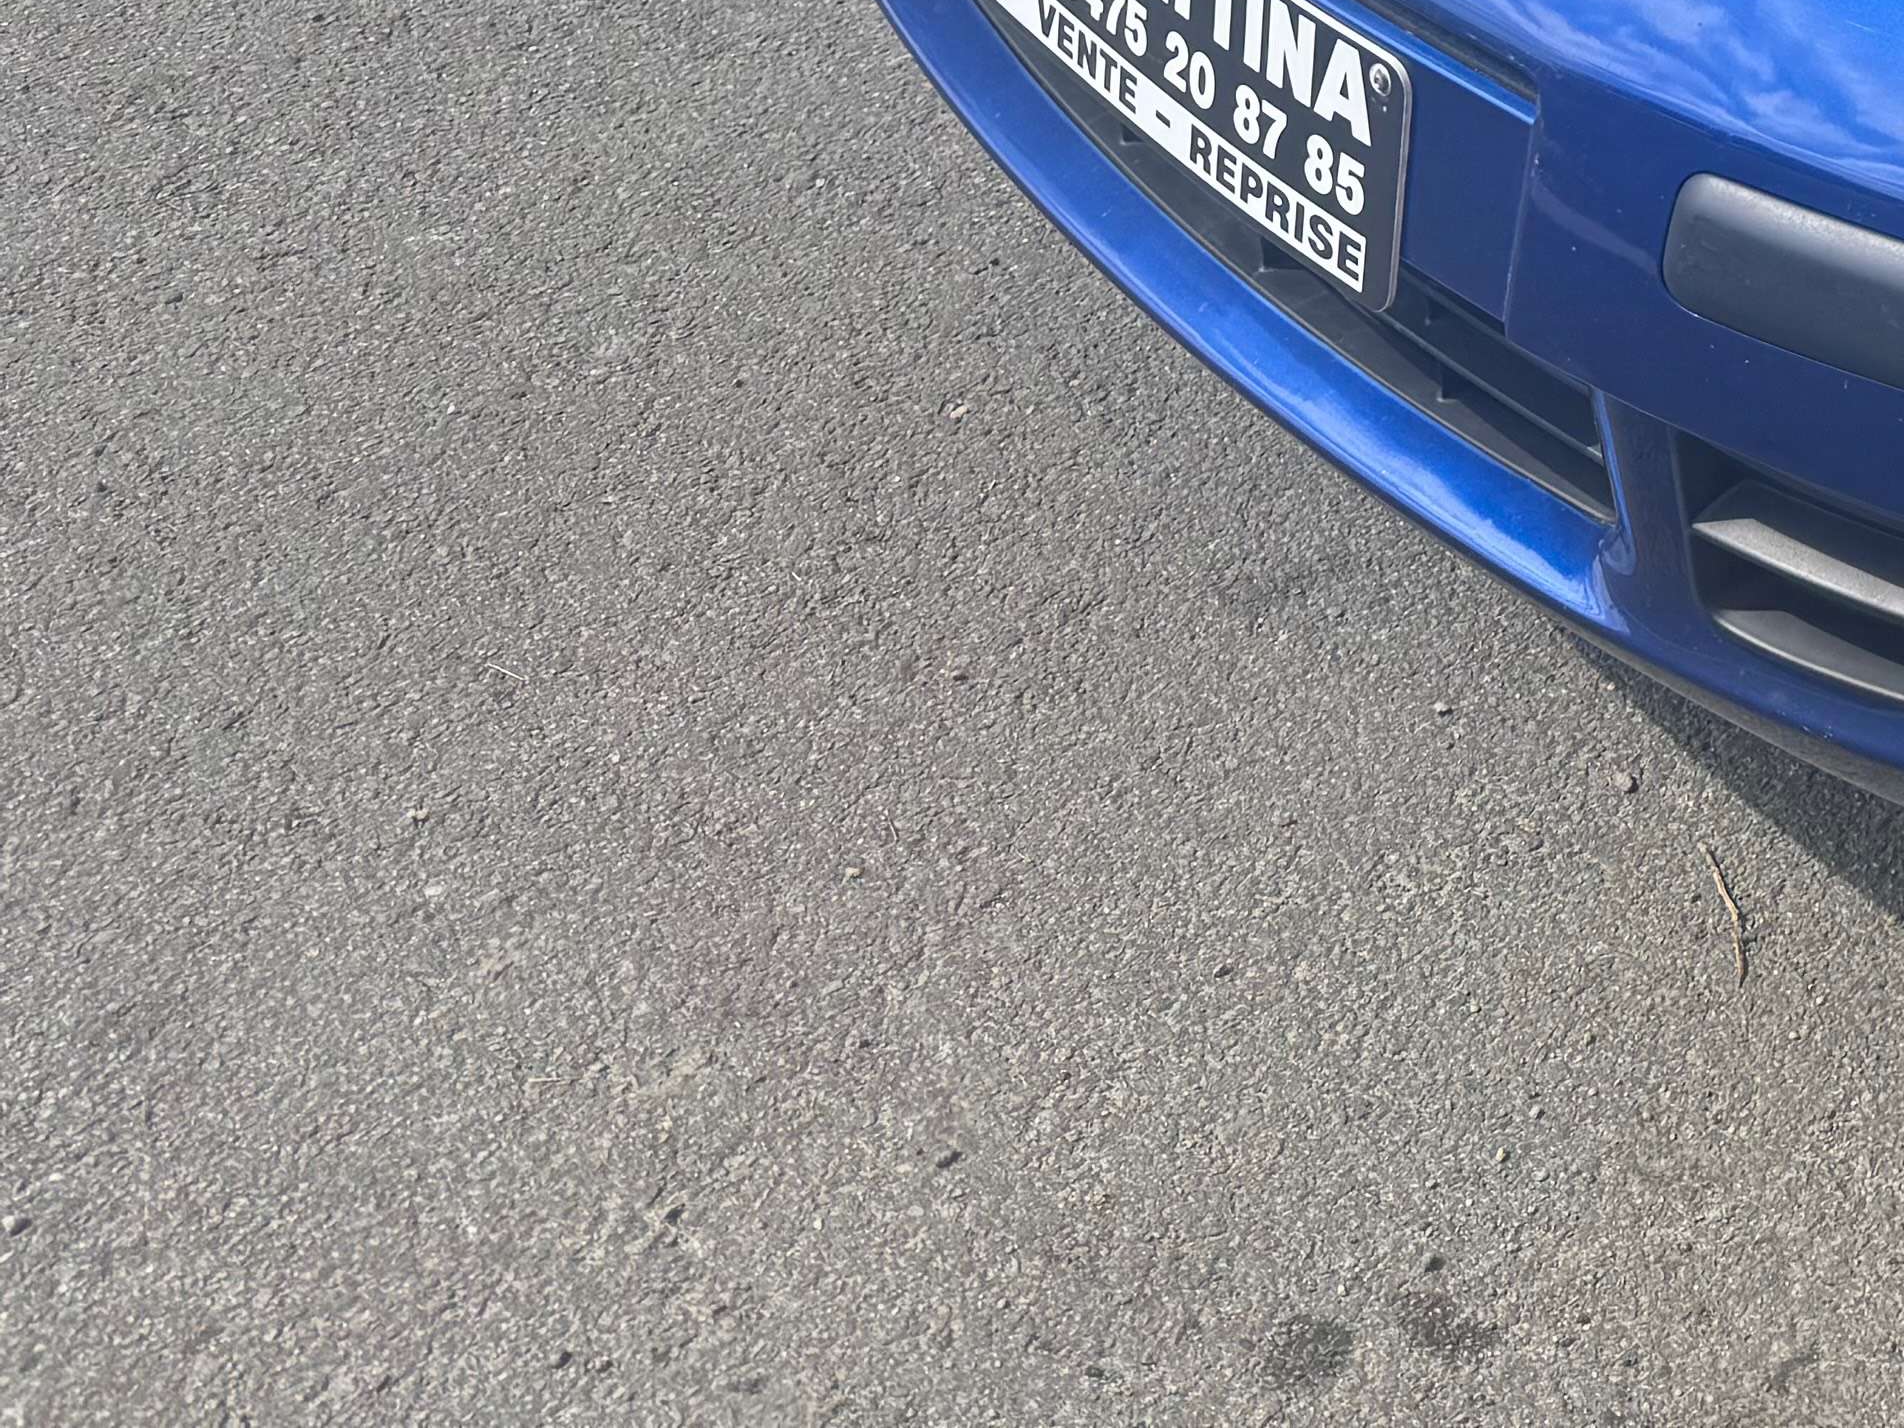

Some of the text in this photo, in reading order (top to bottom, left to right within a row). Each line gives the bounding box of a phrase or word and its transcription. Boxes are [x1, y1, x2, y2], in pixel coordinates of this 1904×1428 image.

[1038, 1, 1138, 112] VENTE
[1189, 124, 1364, 284] REPRISE
[1163, 30, 1216, 111] 20
[1232, 84, 1289, 161] 87
[1304, 139, 1366, 217] 85
